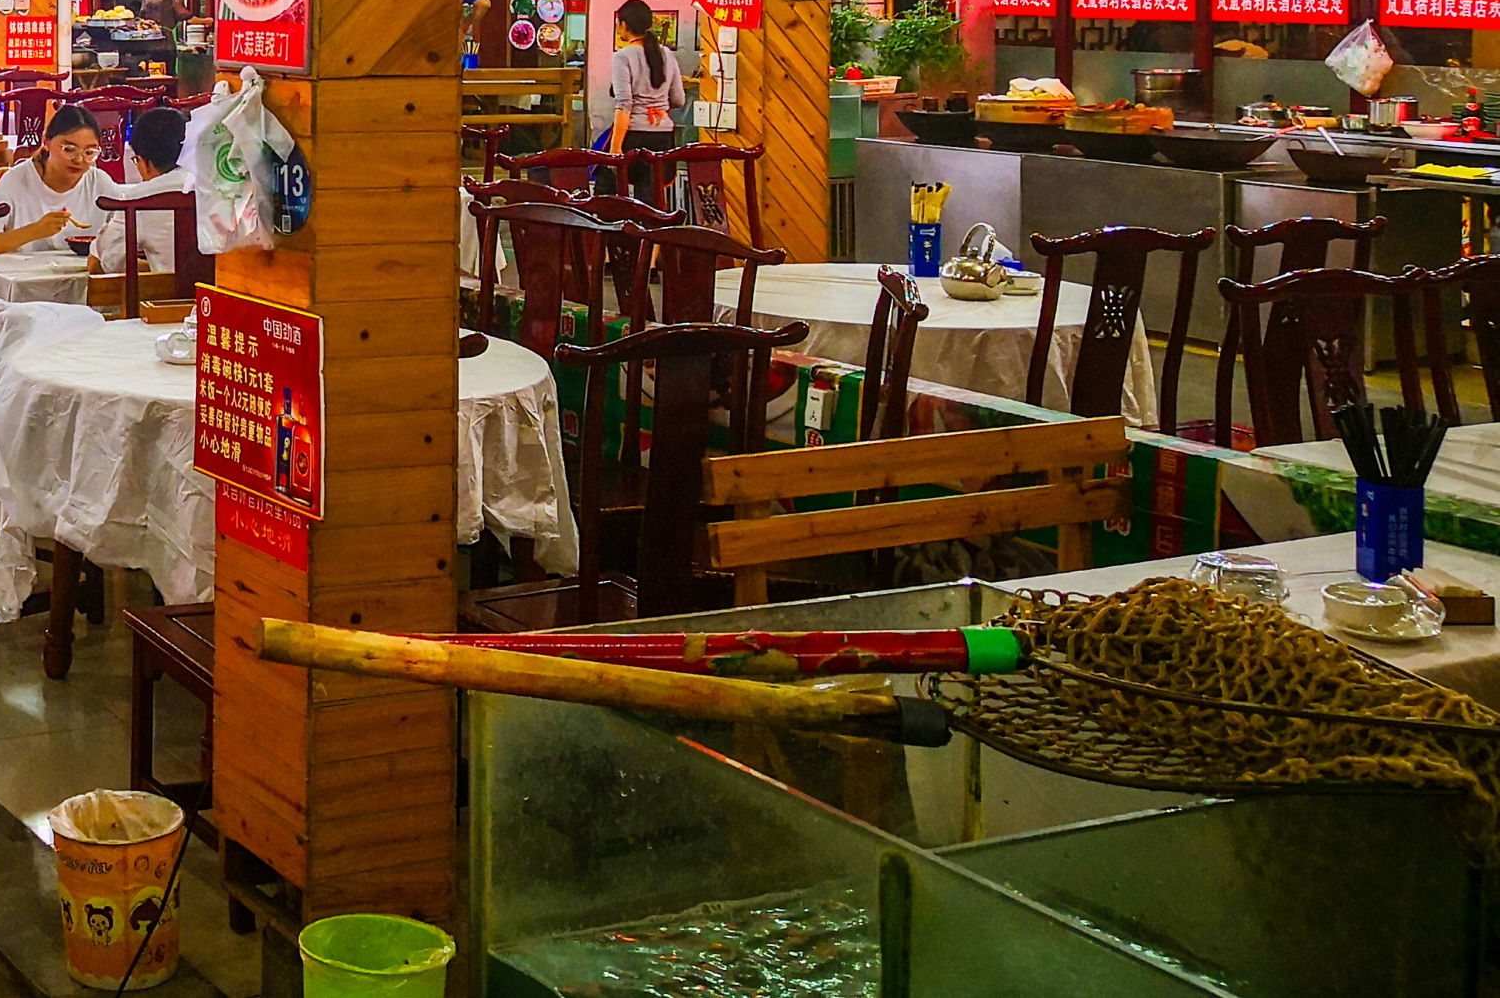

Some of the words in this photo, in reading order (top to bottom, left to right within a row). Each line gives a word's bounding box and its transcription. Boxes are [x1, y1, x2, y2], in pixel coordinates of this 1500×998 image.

[206, 323, 259, 358] 温馨提示
[263, 316, 302, 346] 中国劲酒
[201, 352, 274, 394] 消毒碗筷1元1套
[200, 404, 272, 448] 妥善保管好贵重物品
[199, 429, 241, 463] 小心地滑
